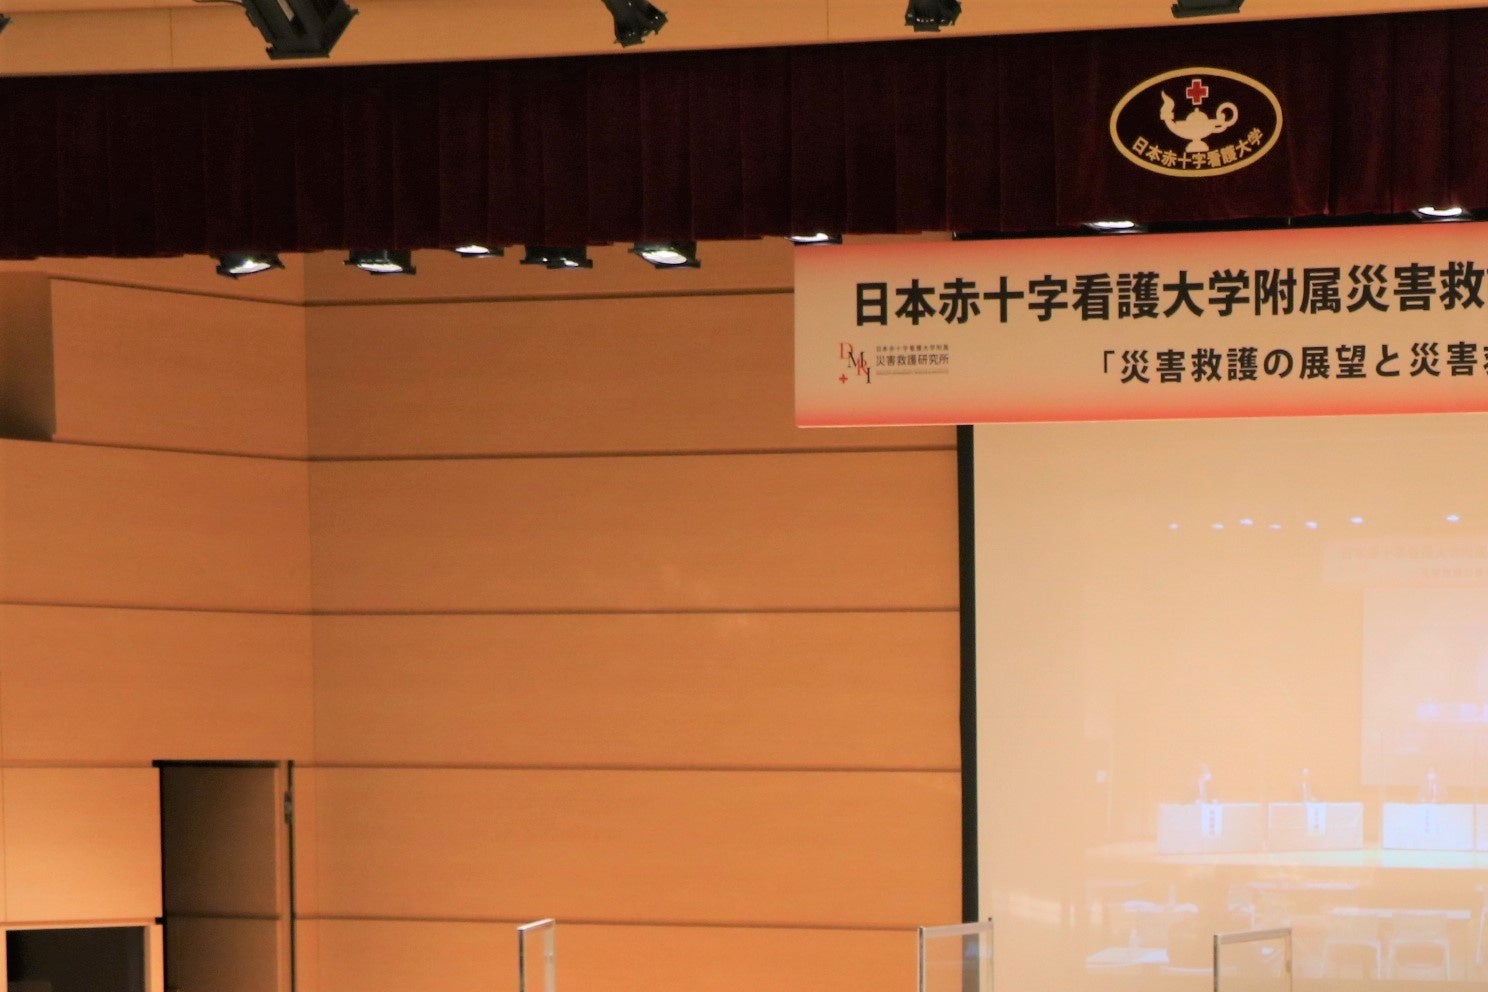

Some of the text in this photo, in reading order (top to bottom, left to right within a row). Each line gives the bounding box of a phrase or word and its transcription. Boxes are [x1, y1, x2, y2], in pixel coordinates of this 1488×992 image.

[1132, 127, 1264, 169] 日本赤十字看護大学
